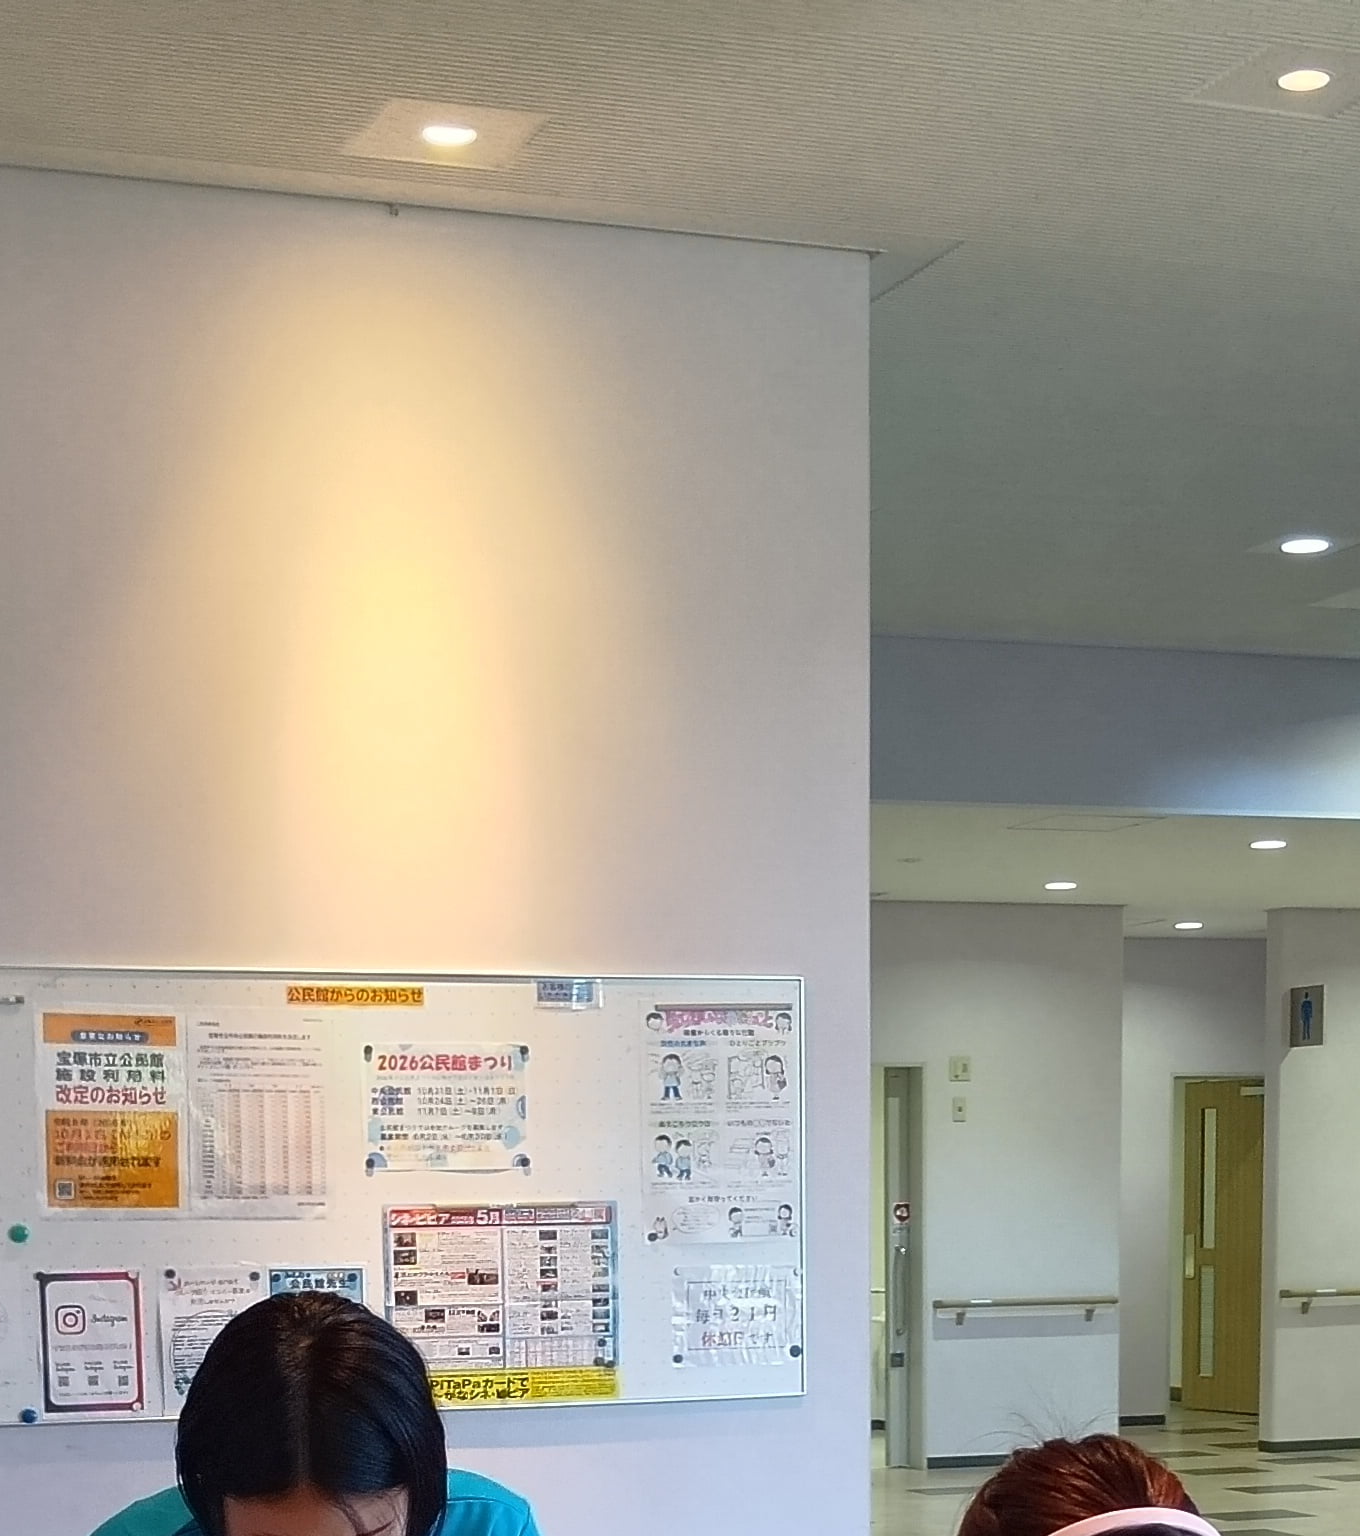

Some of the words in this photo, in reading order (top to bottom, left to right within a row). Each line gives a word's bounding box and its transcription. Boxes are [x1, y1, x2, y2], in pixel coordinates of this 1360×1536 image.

[287, 986, 424, 1004] 公民館からのお知らせ
[55, 1051, 164, 1067] 宝塚市立公民館
[377, 1054, 513, 1071] 2026公民館まつり
[55, 1069, 165, 1082] 施設利用料
[55, 1086, 167, 1105] 改定のお知らせ
[476, 1208, 500, 1225] 5月
